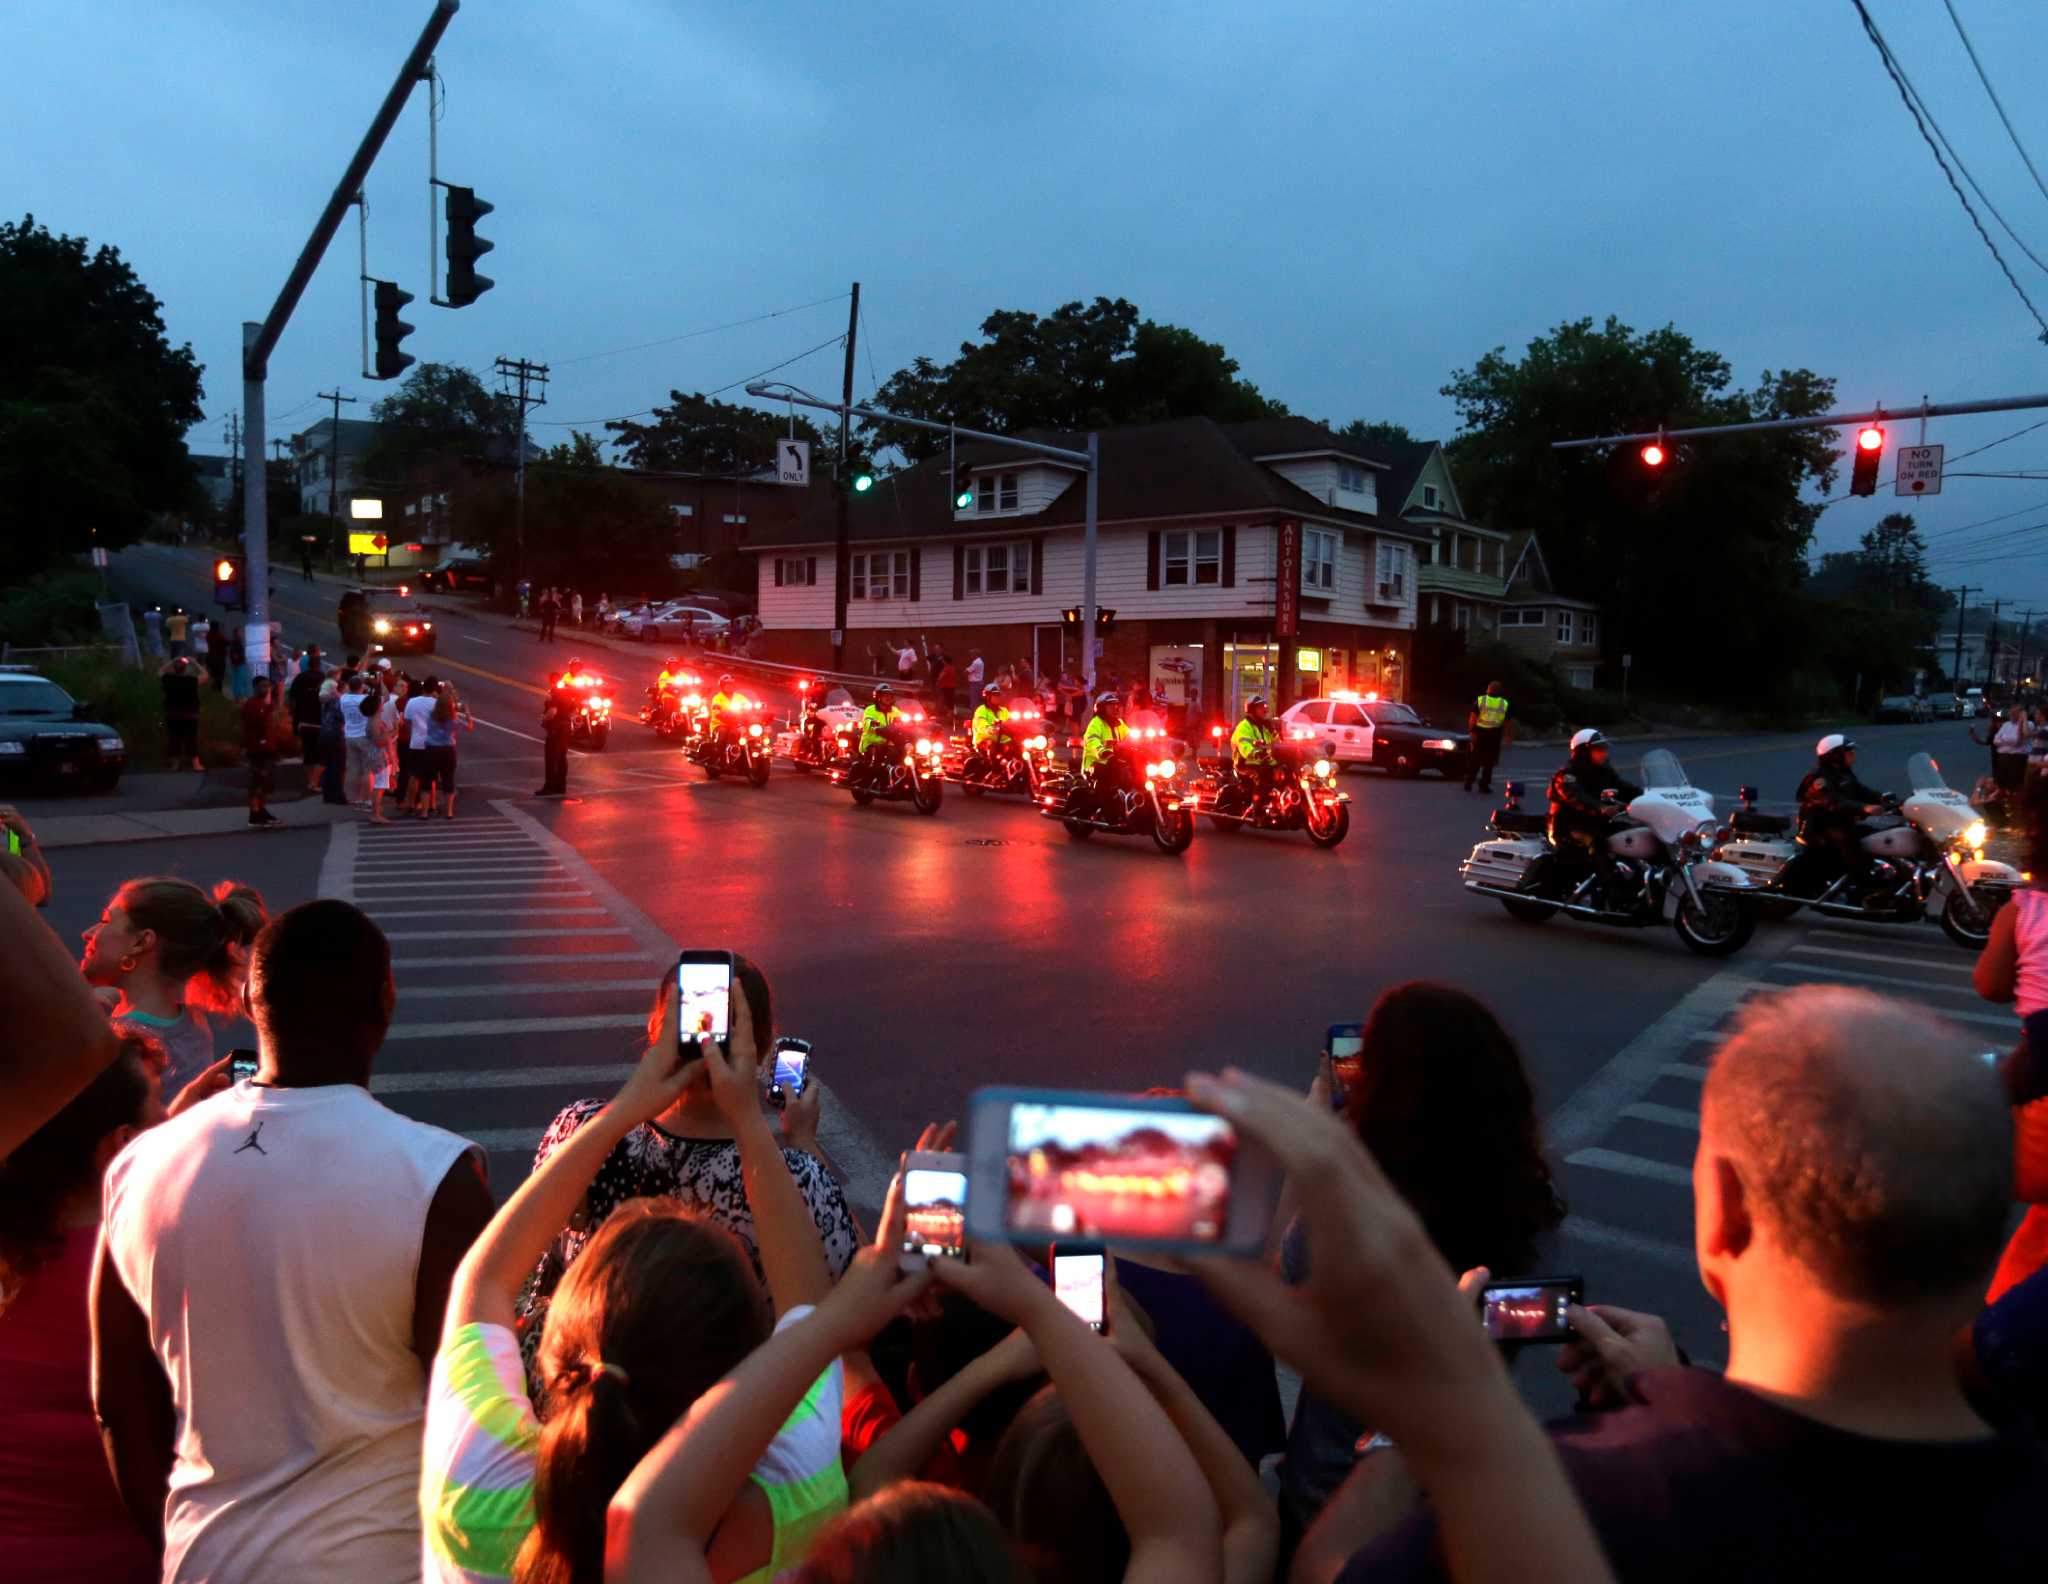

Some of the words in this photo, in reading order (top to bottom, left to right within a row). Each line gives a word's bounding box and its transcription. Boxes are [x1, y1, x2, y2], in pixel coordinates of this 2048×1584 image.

[1912, 449, 1931, 459] NO
[1909, 460, 1933, 469] TURN
[783, 471, 803, 481] ONLY
[1901, 471, 1914, 480] ON
[1919, 469, 1938, 479] RED
